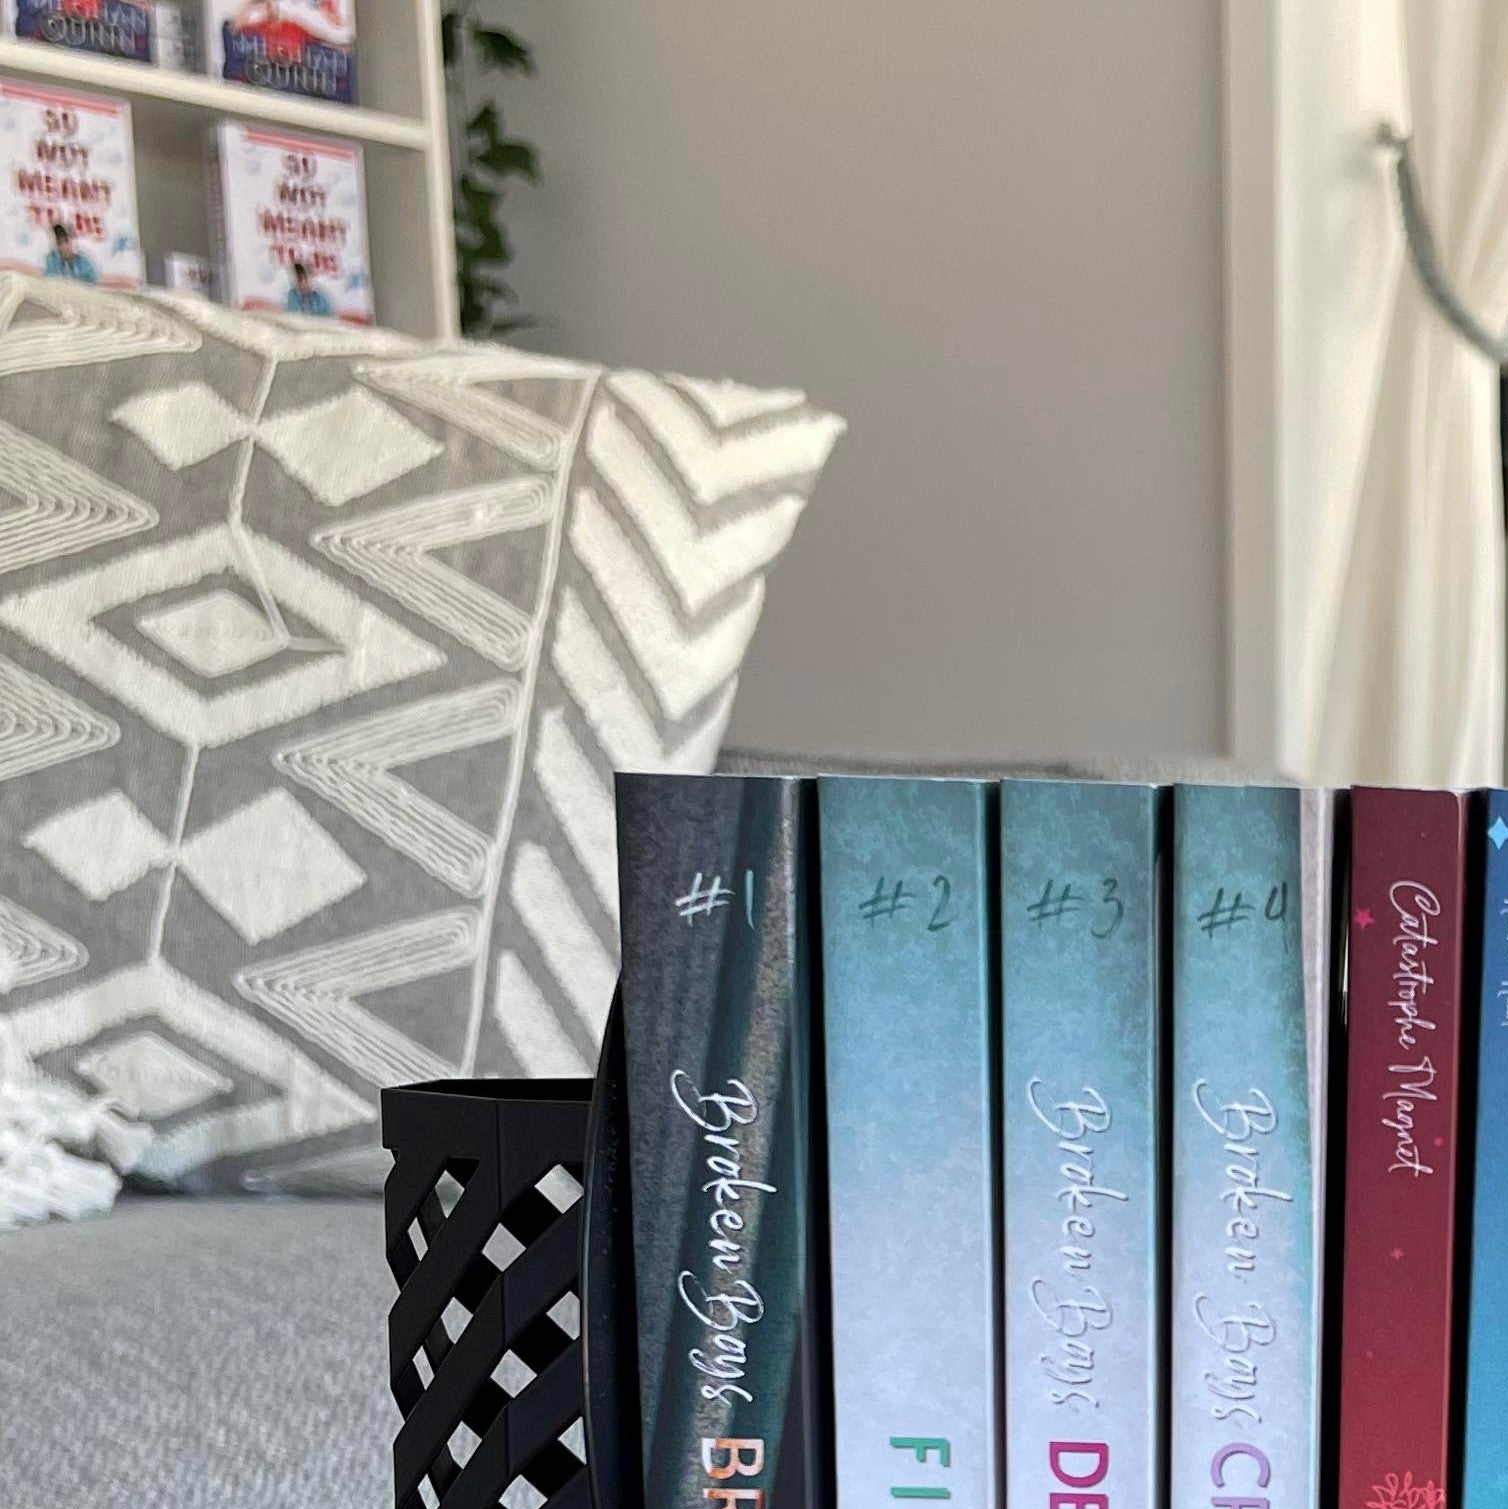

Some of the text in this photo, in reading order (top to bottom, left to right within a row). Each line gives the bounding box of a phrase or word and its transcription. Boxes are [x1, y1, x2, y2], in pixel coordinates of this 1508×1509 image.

[860, 876, 956, 931] #2
[1027, 877, 1124, 939] #3
[1199, 881, 1290, 954] #4
[1382, 880, 1440, 1178] Catastrophe Magnet
[670, 1069, 777, 1404] Broken Boys
[1026, 1077, 1129, 1410] Broken Boys
[1192, 1078, 1294, 1424] Broken Boys
